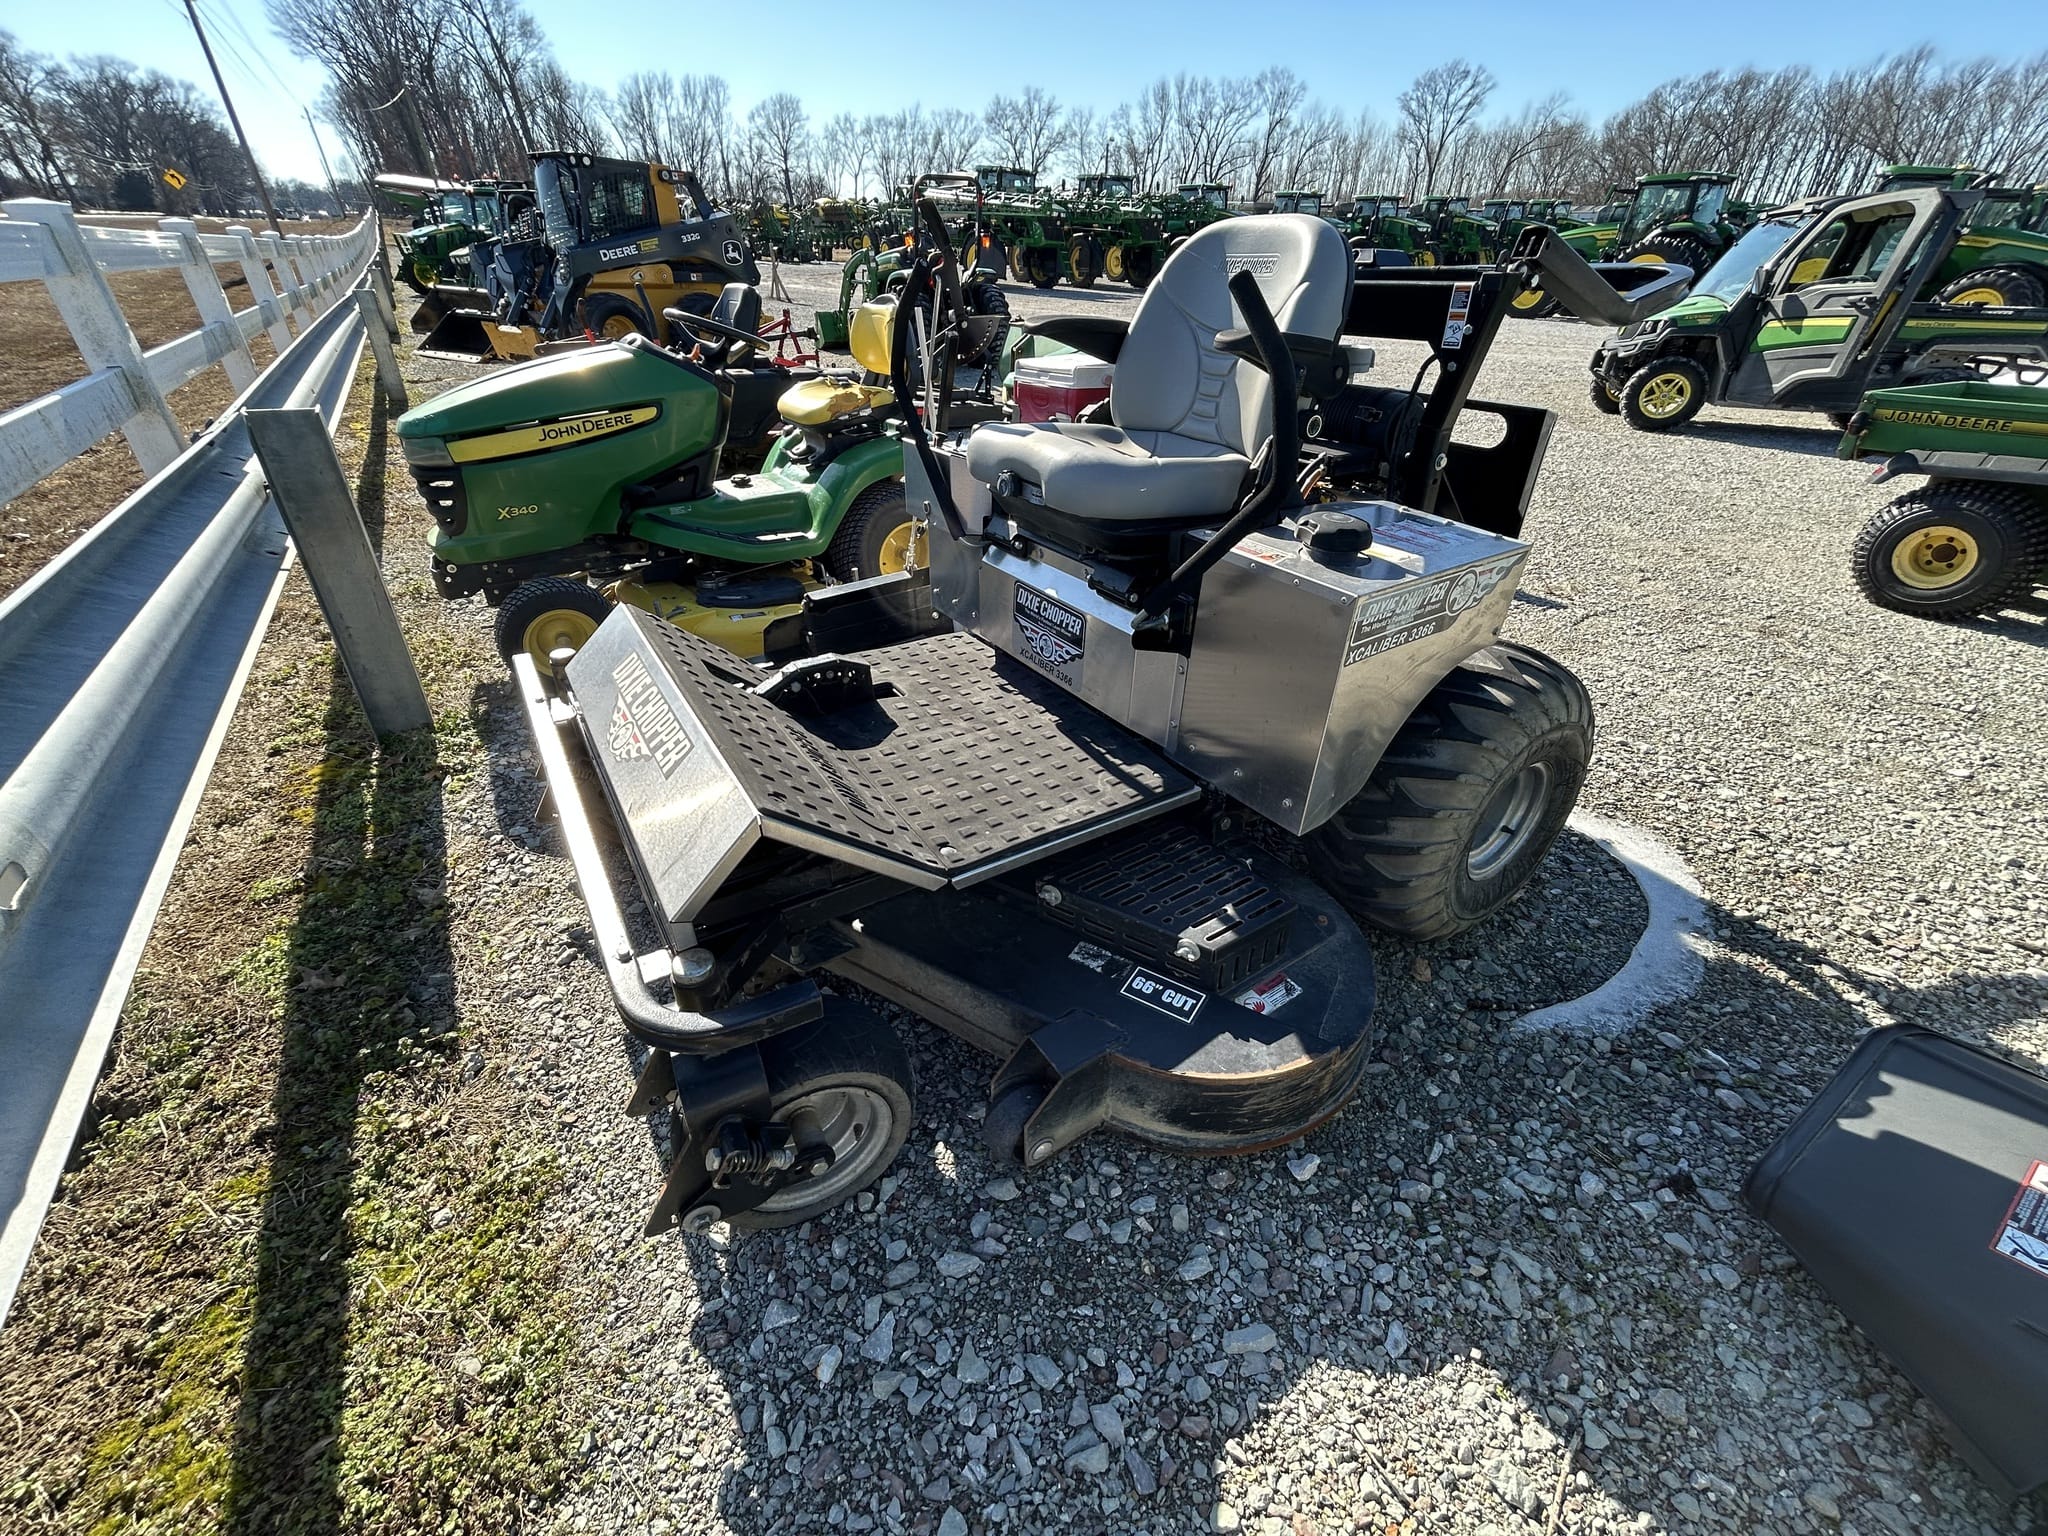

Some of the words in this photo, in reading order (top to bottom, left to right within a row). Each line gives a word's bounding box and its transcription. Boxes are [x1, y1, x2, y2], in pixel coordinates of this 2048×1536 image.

[599, 244, 639, 262] DEERE
[538, 423, 581, 442] JOHN
[582, 413, 634, 433] DEERE
[1884, 410, 1938, 425] JOHN
[1943, 415, 2013, 432] DEERE
[497, 504, 539, 520] X340
[1017, 588, 1041, 613] DIXIE
[1040, 600, 1082, 636] CHOPPER
[1361, 595, 1401, 626] DIXIE
[1396, 580, 1450, 614] CHOPPER
[1346, 631, 1408, 666] XCALIBER
[1408, 622, 1436, 642] 3366
[612, 651, 654, 704] DIXIE
[1020, 648, 1055, 676] XCALIBER
[1055, 669, 1073, 687] 3366
[631, 685, 692, 774] CHOPPER
[1161, 988, 1197, 1012] CUT
